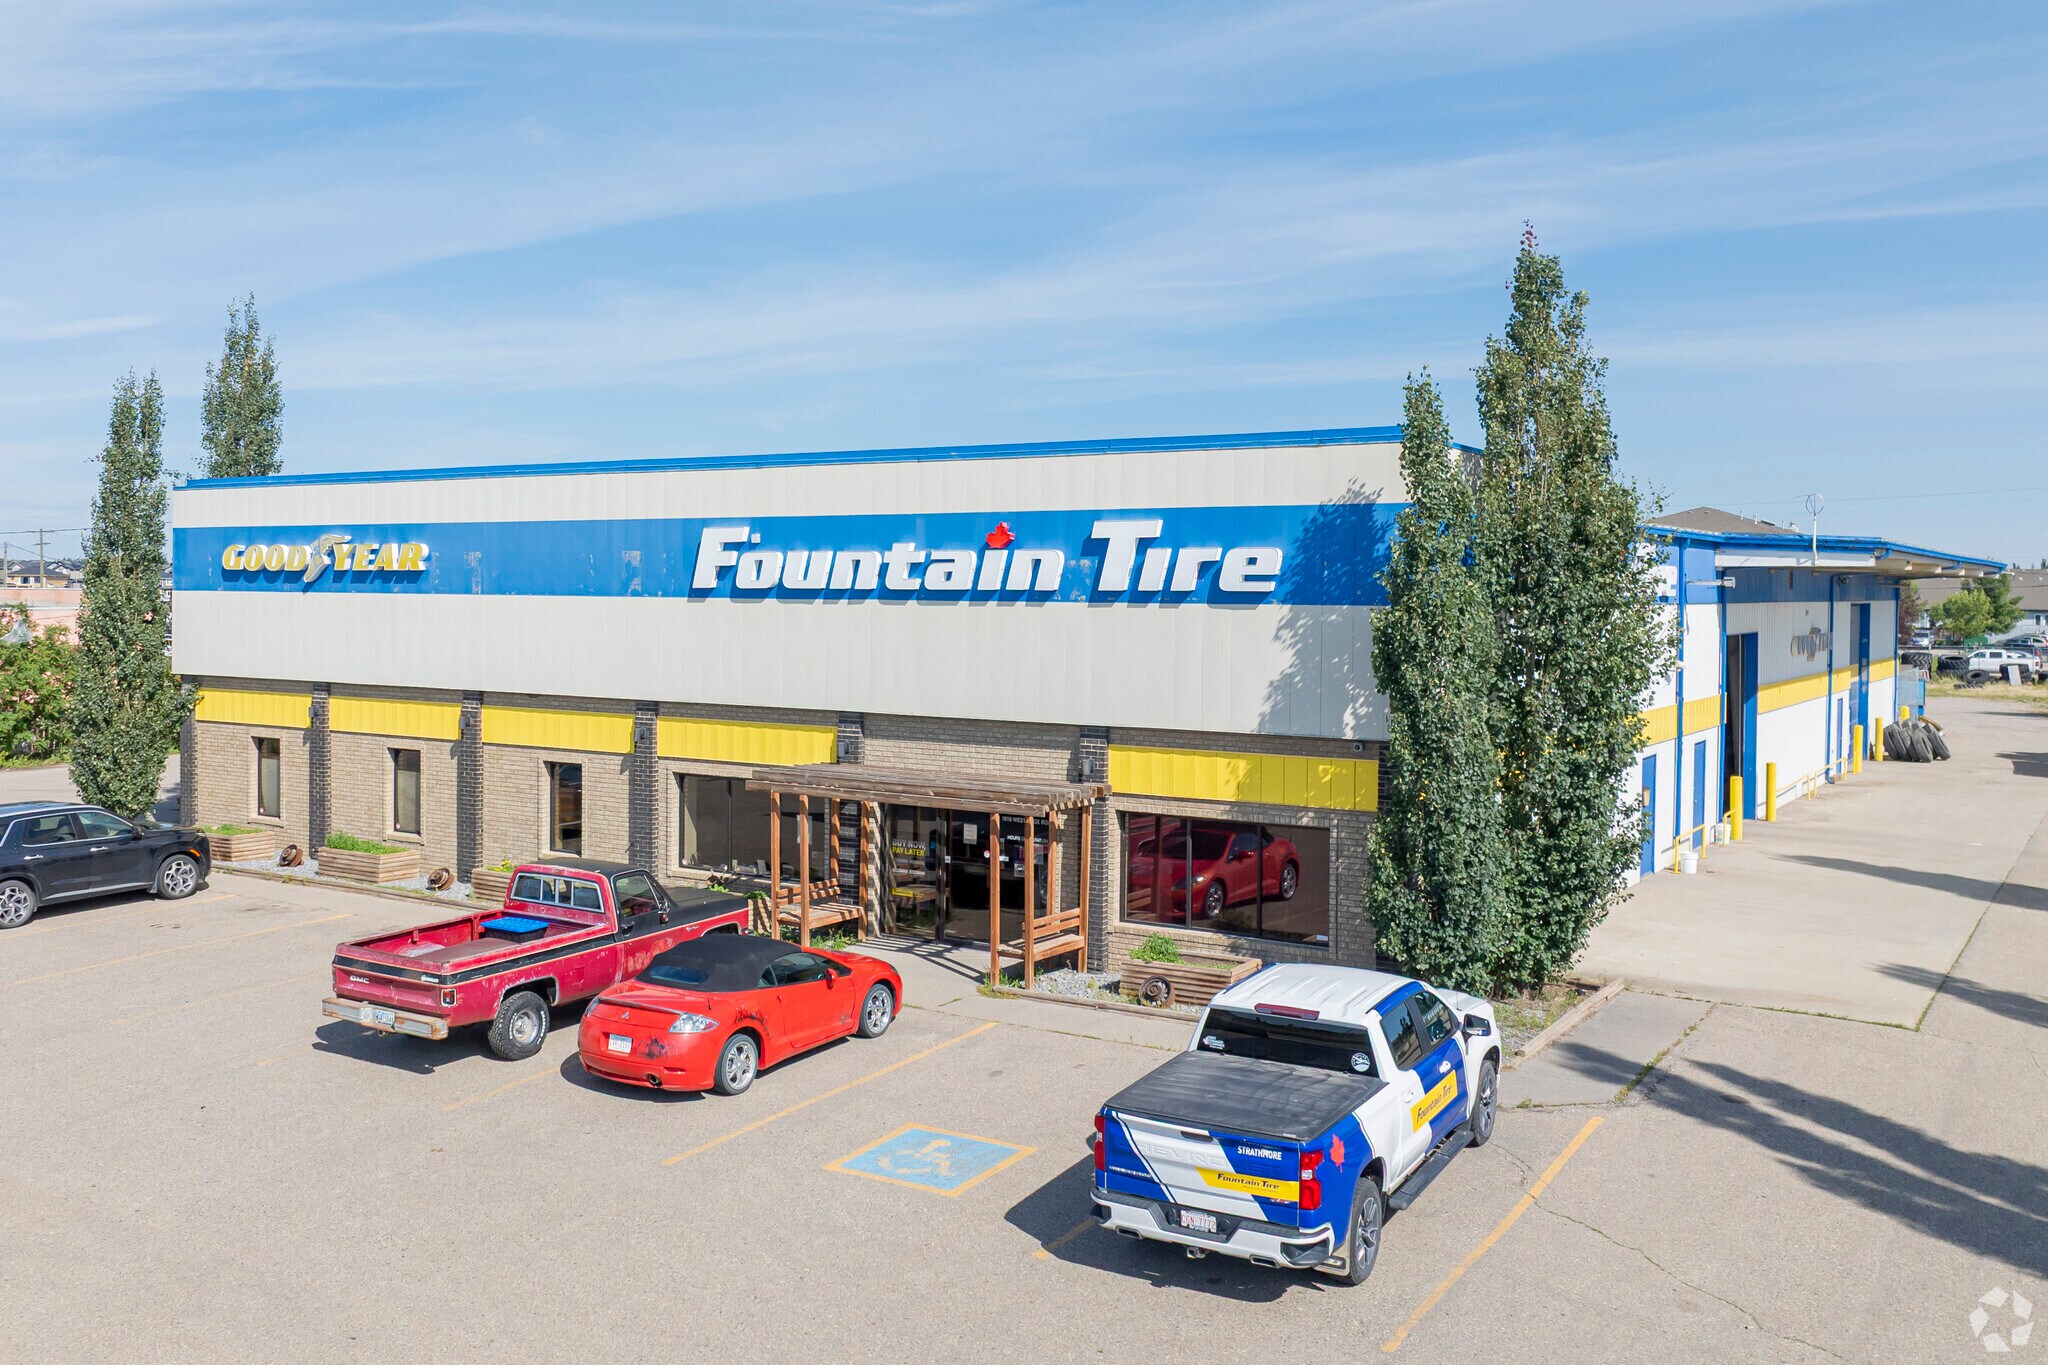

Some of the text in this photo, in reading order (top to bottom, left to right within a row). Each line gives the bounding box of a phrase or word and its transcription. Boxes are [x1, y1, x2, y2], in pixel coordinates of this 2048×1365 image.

[691, 519, 1283, 592] Fountain Tire
[892, 839, 907, 847] BUY
[892, 846, 925, 857] PAY LATER
[349, 975, 370, 984] GMC
[1416, 1094, 1442, 1123] Fountain
[1237, 1145, 1283, 1161] STRATHMORE
[1217, 1173, 1260, 1187] Fountain
[1261, 1180, 1280, 1190] Tire
